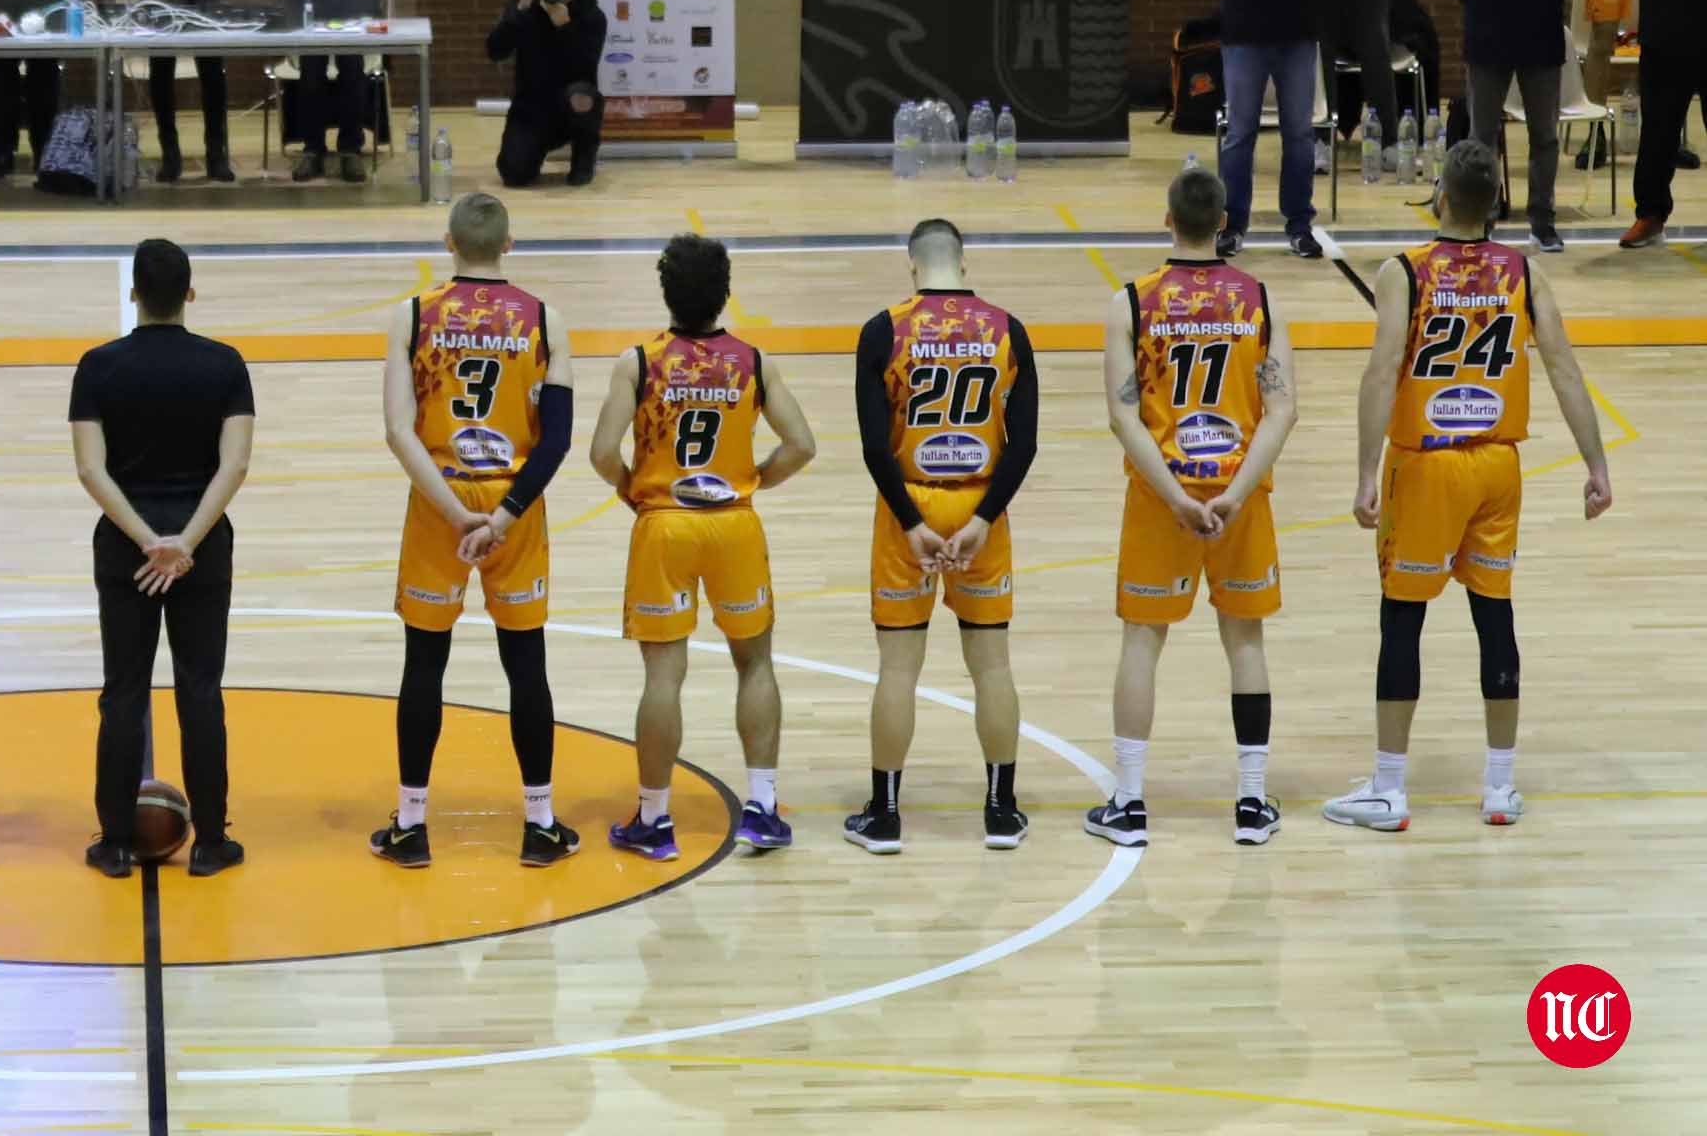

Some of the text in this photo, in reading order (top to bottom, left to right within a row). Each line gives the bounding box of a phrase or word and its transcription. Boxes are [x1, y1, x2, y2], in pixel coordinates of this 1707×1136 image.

[431, 332, 530, 353] HJALMAR
[910, 342, 997, 358] MULERO
[1149, 322, 1257, 337] HILMARSSON
[1411, 313, 1517, 380] 24
[449, 356, 502, 421] 3
[663, 387, 741, 403] ARTURO
[907, 364, 1000, 427] 20
[1168, 340, 1232, 409] 11
[675, 407, 724, 470] 8
